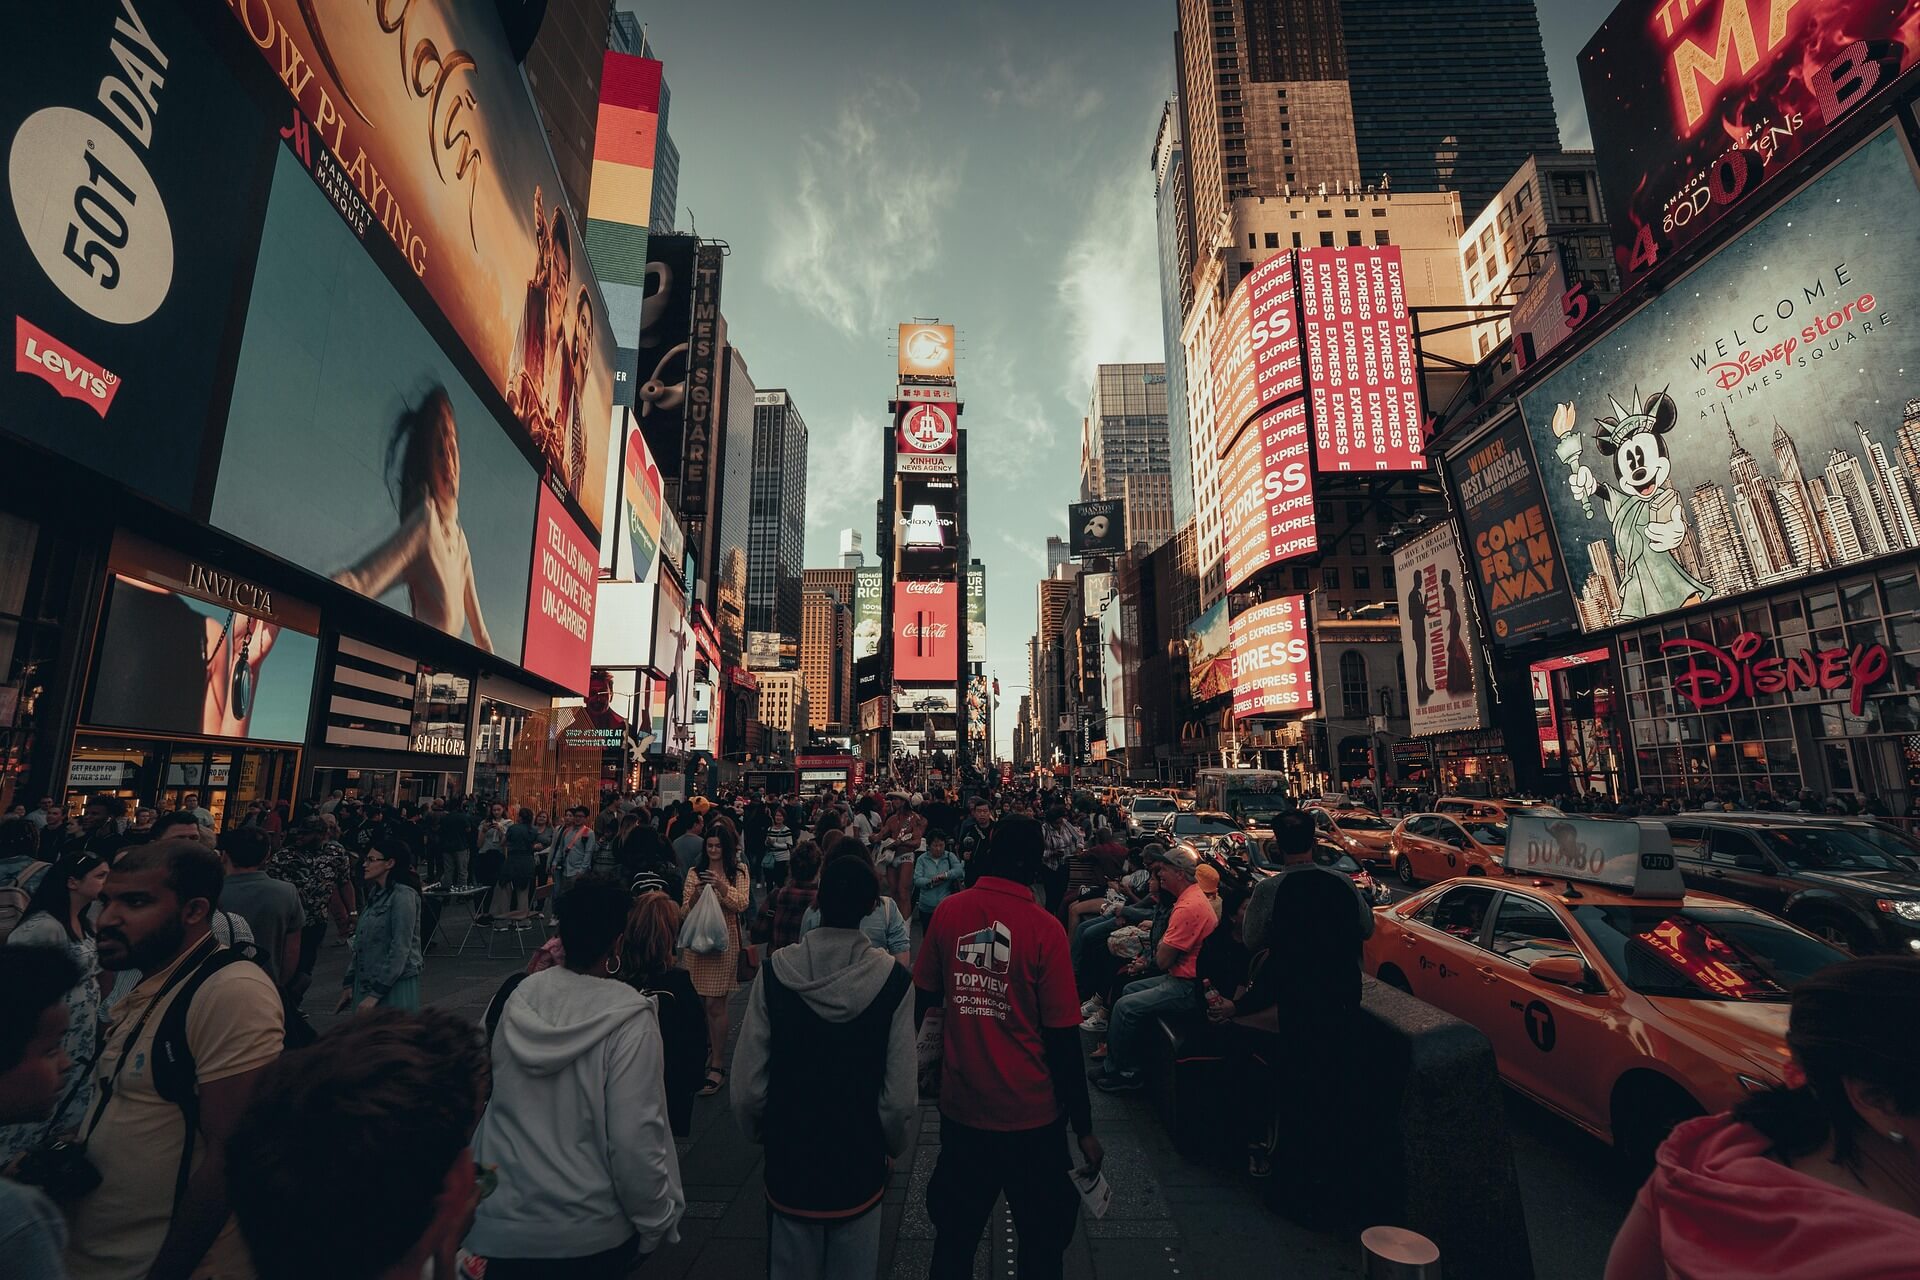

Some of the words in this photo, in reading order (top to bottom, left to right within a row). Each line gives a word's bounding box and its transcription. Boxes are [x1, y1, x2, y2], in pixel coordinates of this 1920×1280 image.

[313, 87, 427, 278] PLAYING
[316, 166, 365, 239] MARQUIS
[318, 149, 373, 227] MARRIOTT
[1663, 170, 1705, 212] AMAZON
[696, 268, 717, 355] TIMES
[1302, 258, 1318, 315] EXPRESS
[1319, 264, 1335, 321] EXPRESS
[1336, 258, 1352, 314] EXPRESS
[1355, 263, 1370, 320] EXPRESS
[1370, 257, 1387, 314] EXPRESS
[1388, 262, 1404, 319] EXPRESS
[1690, 262, 1853, 371] WELCOME
[1214, 309, 1291, 406] EXPRESS
[1307, 322, 1324, 381] EXPRESS
[1326, 328, 1342, 386] EXPRESS
[1343, 321, 1359, 380] EXPRESS
[1362, 326, 1378, 385] EXPRESS
[1378, 321, 1394, 380] EXPRESS
[1396, 325, 1412, 385] EXPRESS
[1695, 387, 1707, 398] TO
[1801, 293, 1877, 345] store
[1700, 404, 1716, 420] AT
[1727, 369, 1784, 404] TIMES
[1798, 311, 1892, 368] SQUARE
[688, 367, 711, 481] SQUARE
[1314, 388, 1330, 449] EXPRESS
[1332, 394, 1348, 454] EXPRESS
[1349, 387, 1366, 448] EXPRESS
[1369, 393, 1385, 453] EXPRESS
[1385, 387, 1402, 448] EXPRESS
[1403, 392, 1420, 453] EXPRESS
[909, 457, 945, 466] XINHUA
[1460, 472, 1482, 501] BEST
[1482, 447, 1526, 487] MUSICAL
[1078, 504, 1114, 513] PHANTOM
[1223, 463, 1306, 538] EXPRESS
[1242, 510, 1267, 537] EXPRESS
[548, 516, 566, 561] TELL
[567, 540, 577, 571] US
[577, 551, 593, 585] WHY
[1242, 531, 1267, 556] EXPRESS
[1404, 545, 1418, 560] HAVE
[1476, 504, 1544, 556] COME
[187, 561, 274, 614] INVICTA
[542, 548, 559, 587] YOU
[559, 567, 579, 604] LOVE
[579, 586, 592, 616] THE
[1089, 577, 1105, 588] MY
[1244, 549, 1270, 573] EXPRESS
[1491, 559, 1555, 610] AWAY
[541, 585, 587, 642] UN-CARRIER
[1248, 602, 1292, 624] EXPRESS
[1423, 563, 1439, 622] PRETTY
[1249, 620, 1293, 640] EXPRESS
[1231, 639, 1307, 679] EXPRESS
[1253, 673, 1297, 690] EXPRESS
[1431, 627, 1449, 691] WOMAN
[1254, 692, 1299, 708] EXPRESS
[415, 734, 466, 756] SEPHORA
[954, 972, 1009, 993] TOPVIEW
[1531, 1008, 1549, 1045] T
